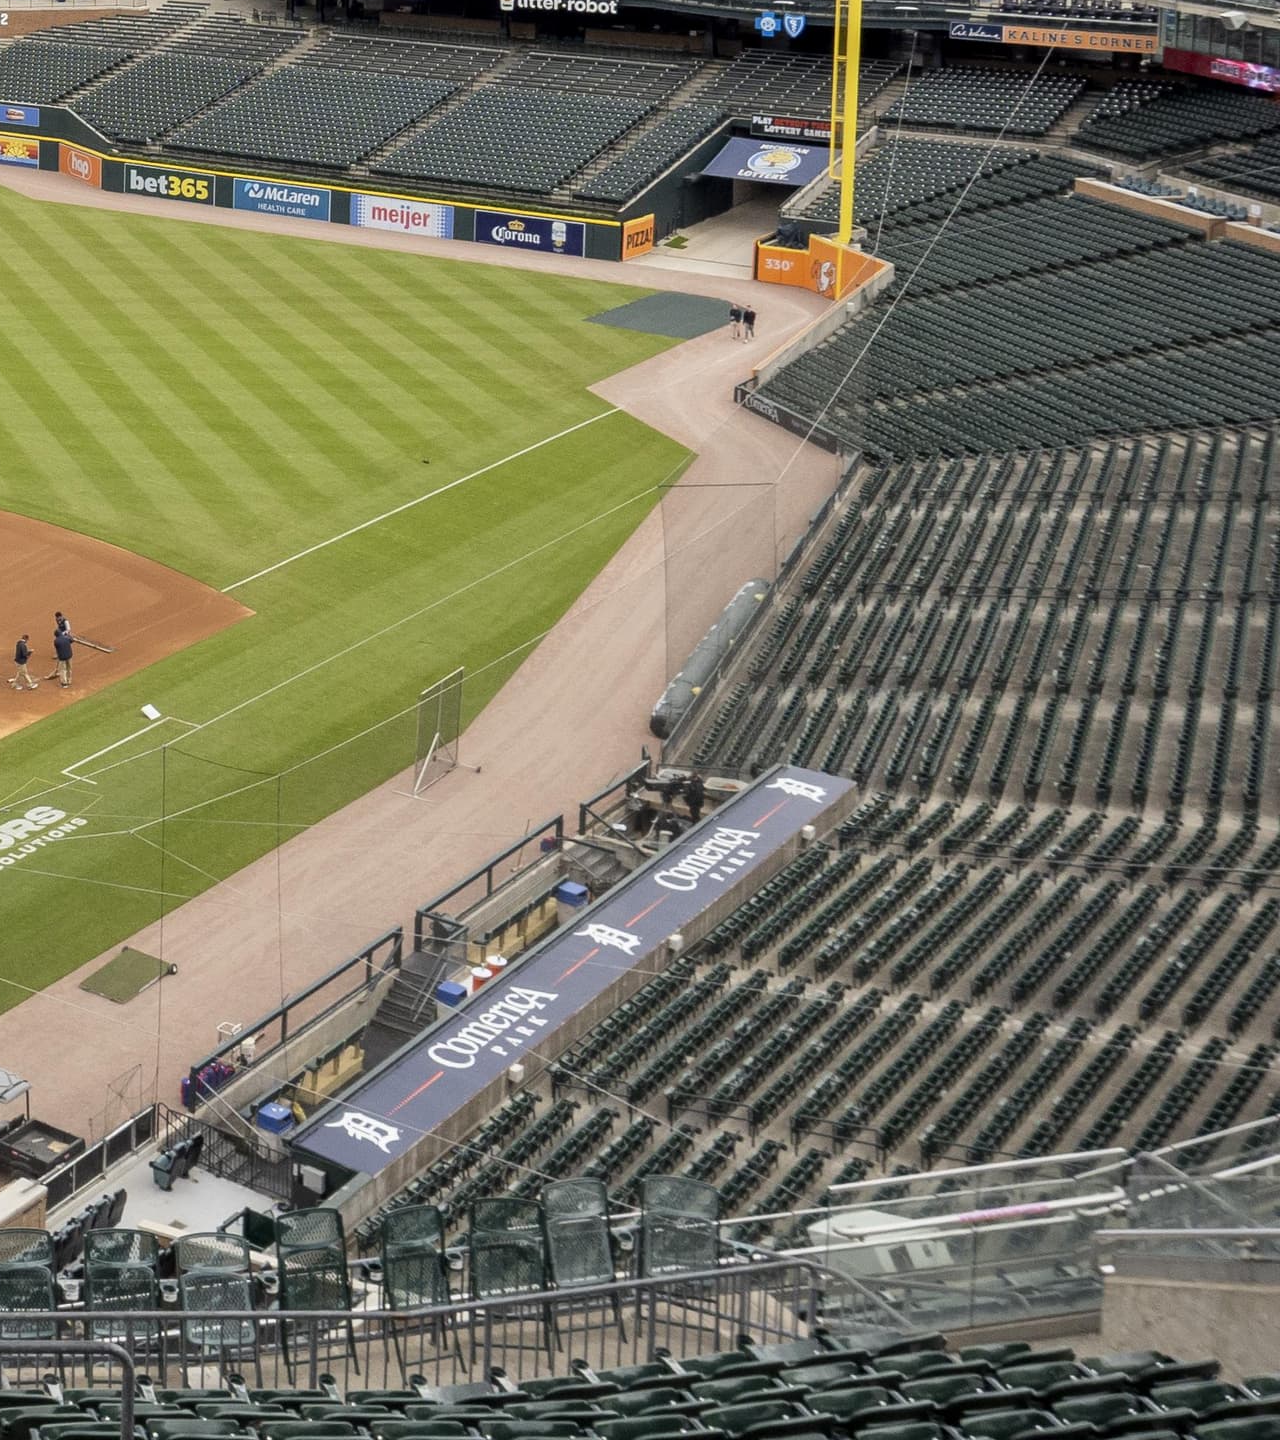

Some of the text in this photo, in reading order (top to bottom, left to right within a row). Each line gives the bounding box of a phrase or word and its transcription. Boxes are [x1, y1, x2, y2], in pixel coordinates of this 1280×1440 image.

[1090, 36, 1155, 50] CORNER
[752, 116, 772, 126] PLAY
[765, 125, 801, 135] LOTTERY
[760, 143, 810, 154] MICHIGAN
[71, 152, 88, 176] hap
[737, 169, 789, 181] LOTTERY
[130, 170, 209, 200] bet365
[265, 187, 319, 207] McLaren
[258, 203, 306, 215] HEALTH CARE
[372, 205, 430, 229] meijer
[491, 225, 540, 244] Corona
[626, 228, 653, 250] PIZZA!
[713, 848, 757, 882] PARK
[490, 1015, 549, 1057] PARK
